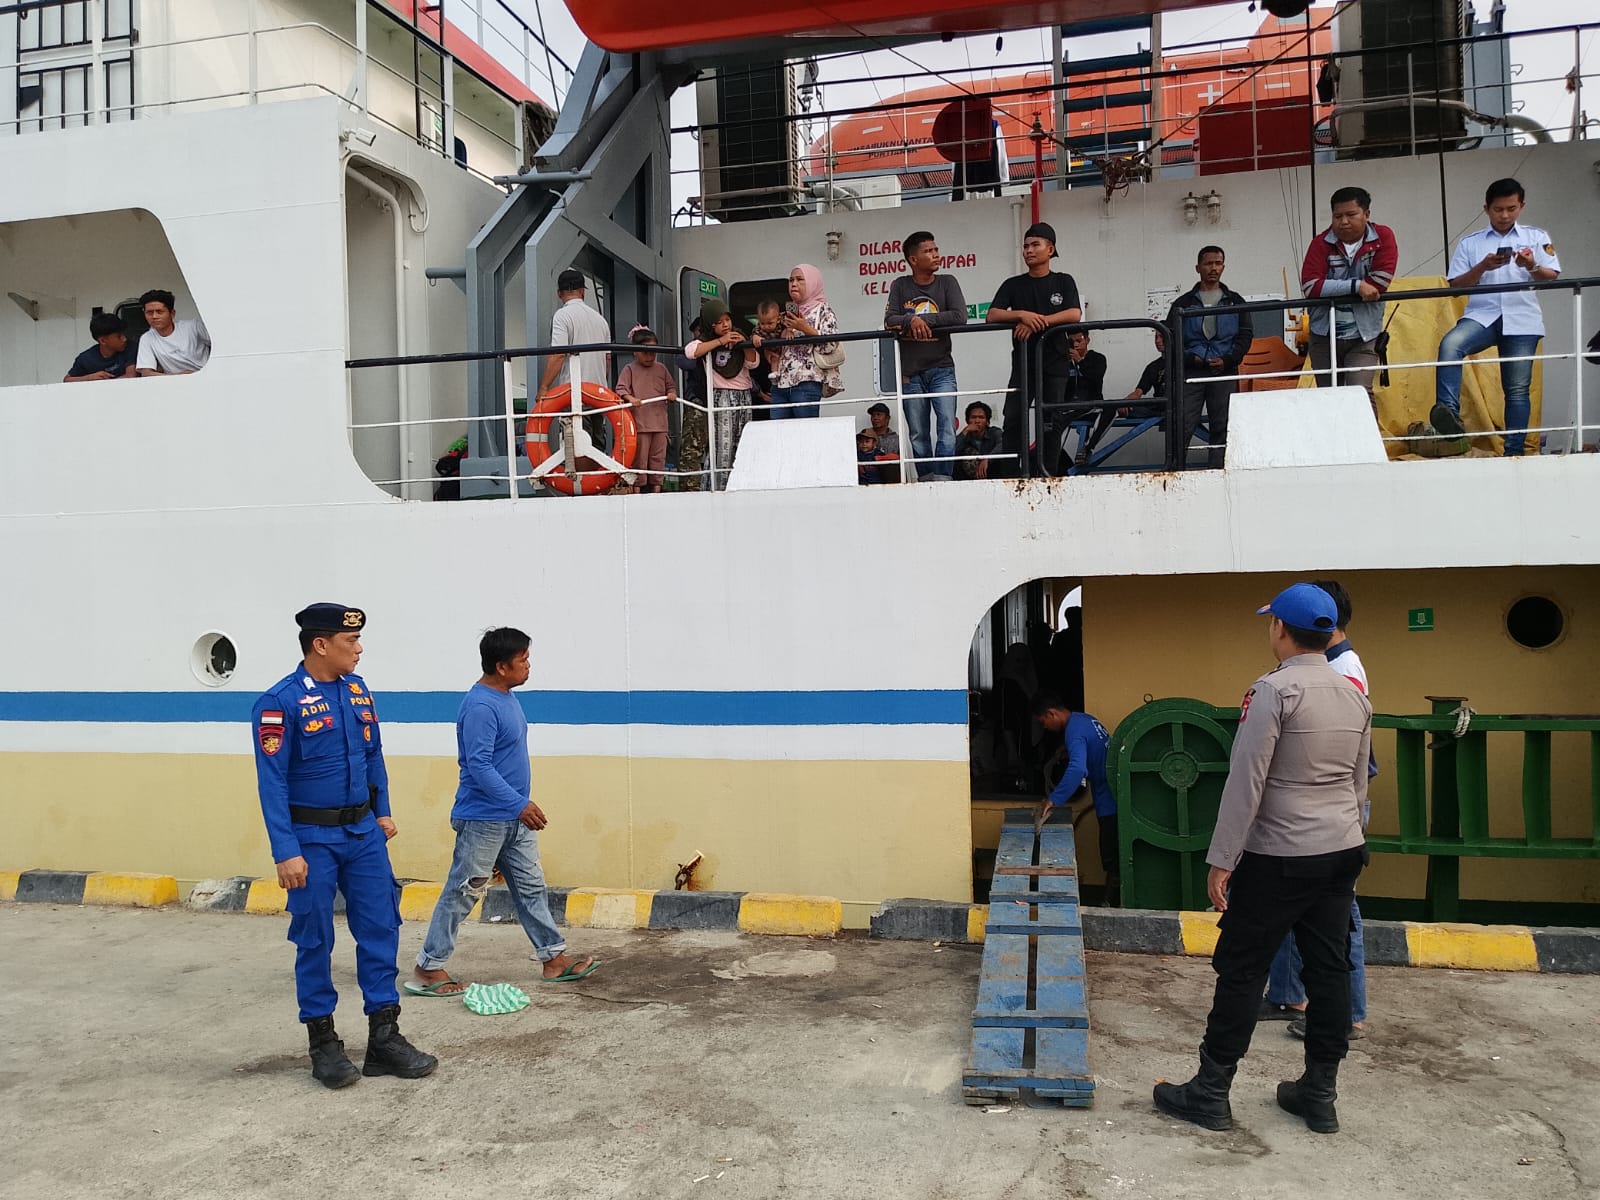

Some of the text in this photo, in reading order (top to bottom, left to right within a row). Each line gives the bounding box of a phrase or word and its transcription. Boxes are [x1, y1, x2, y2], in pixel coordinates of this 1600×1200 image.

[859, 259, 907, 276] BUANG
[700, 280, 717, 294] EXIT
[302, 702, 330, 717] ADHI
